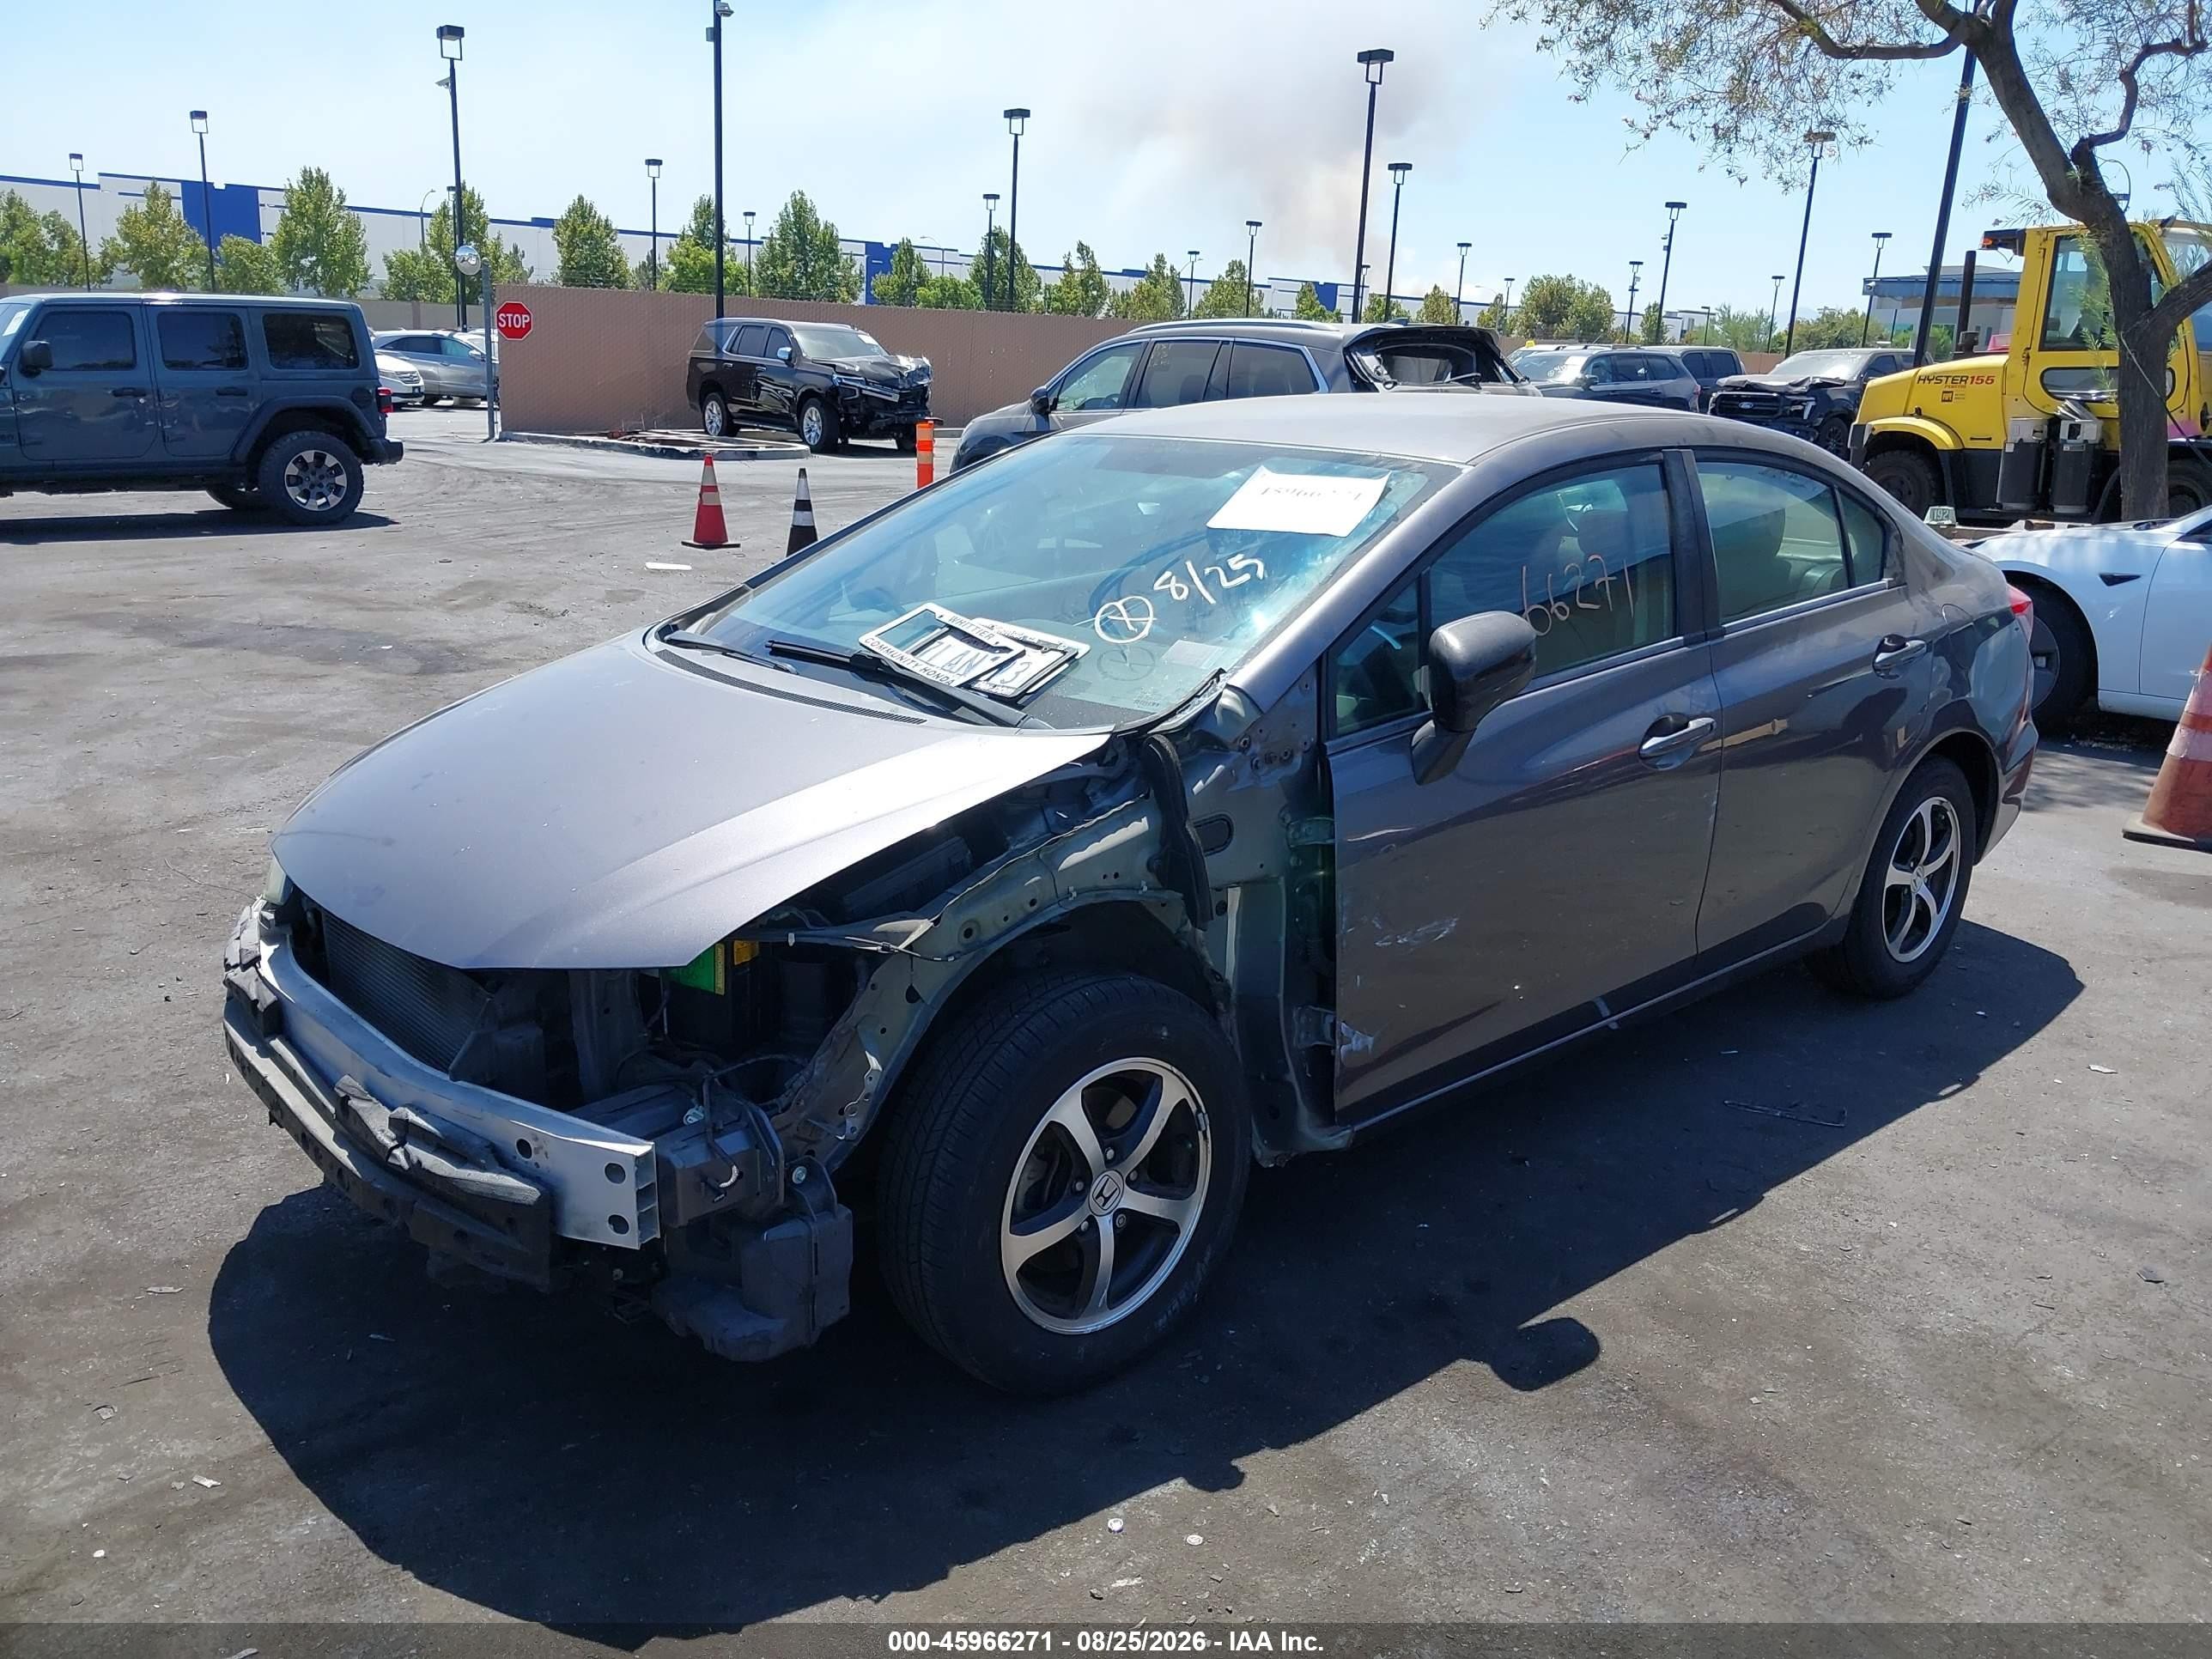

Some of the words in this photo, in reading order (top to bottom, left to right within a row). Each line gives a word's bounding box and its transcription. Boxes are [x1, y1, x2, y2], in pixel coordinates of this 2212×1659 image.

[498, 313, 531, 328] STOP
[1917, 375, 1969, 385] HYSTER
[1153, 553, 1265, 605] 8/25
[1522, 554, 1634, 636] 66271
[948, 615, 995, 641] WHITTIER
[865, 637, 923, 669] COMMUNITY
[920, 666, 955, 685] HONDA
